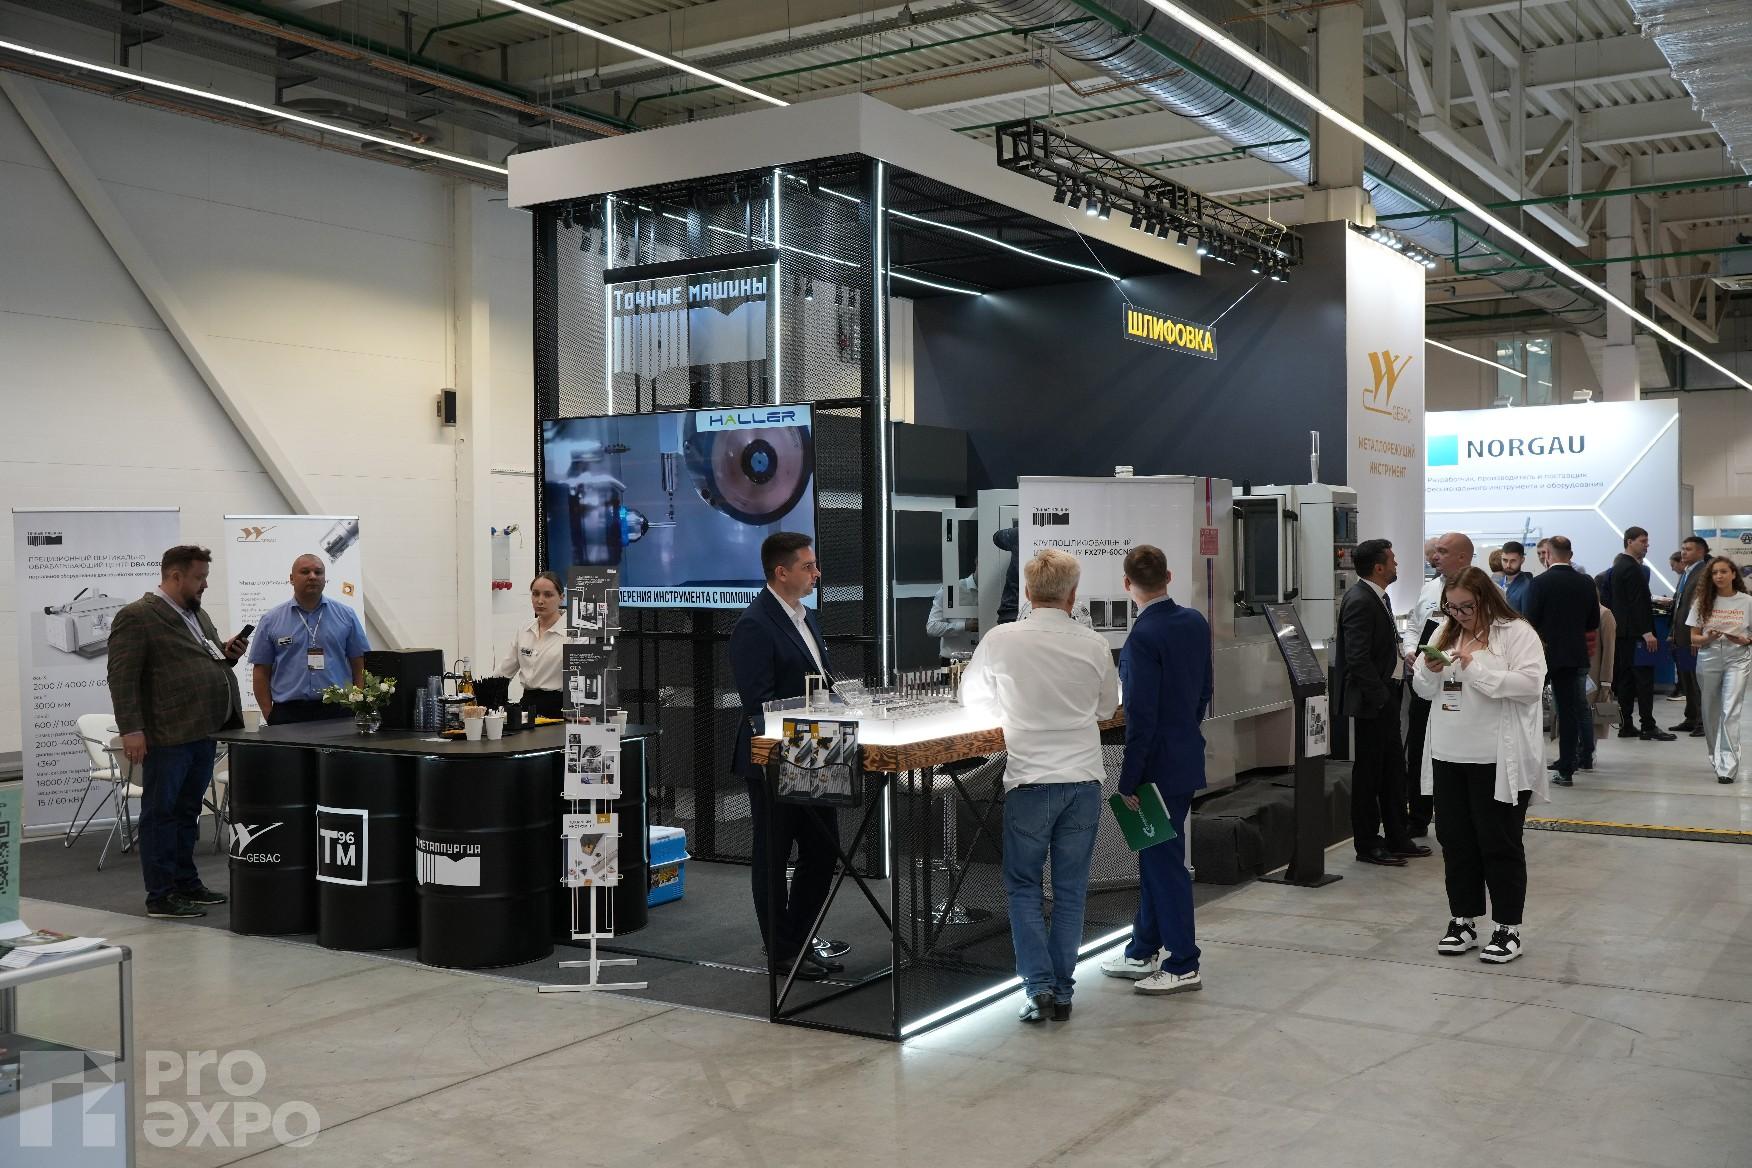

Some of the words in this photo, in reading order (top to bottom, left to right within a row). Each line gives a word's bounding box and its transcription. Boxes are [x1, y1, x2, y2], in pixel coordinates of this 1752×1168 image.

[1128, 310, 1214, 353] ШЛИФОВКА
[709, 411, 796, 426] HALLER
[1358, 436, 1415, 459] МЕТАЛЛОРЕЖУЩИЙ
[1467, 435, 1585, 458] NORGAU
[1369, 462, 1407, 478] ИНСТРУМЕНТ
[654, 591, 711, 603] ИНСТРУМЕНТА
[712, 591, 718, 603] С
[33, 683, 55, 691] 2000
[65, 680, 87, 688] 4000
[33, 702, 56, 710] 3000
[34, 721, 52, 729] 600
[37, 799, 46, 807] 15
[337, 831, 355, 844] 96
[246, 853, 281, 863] GESAC
